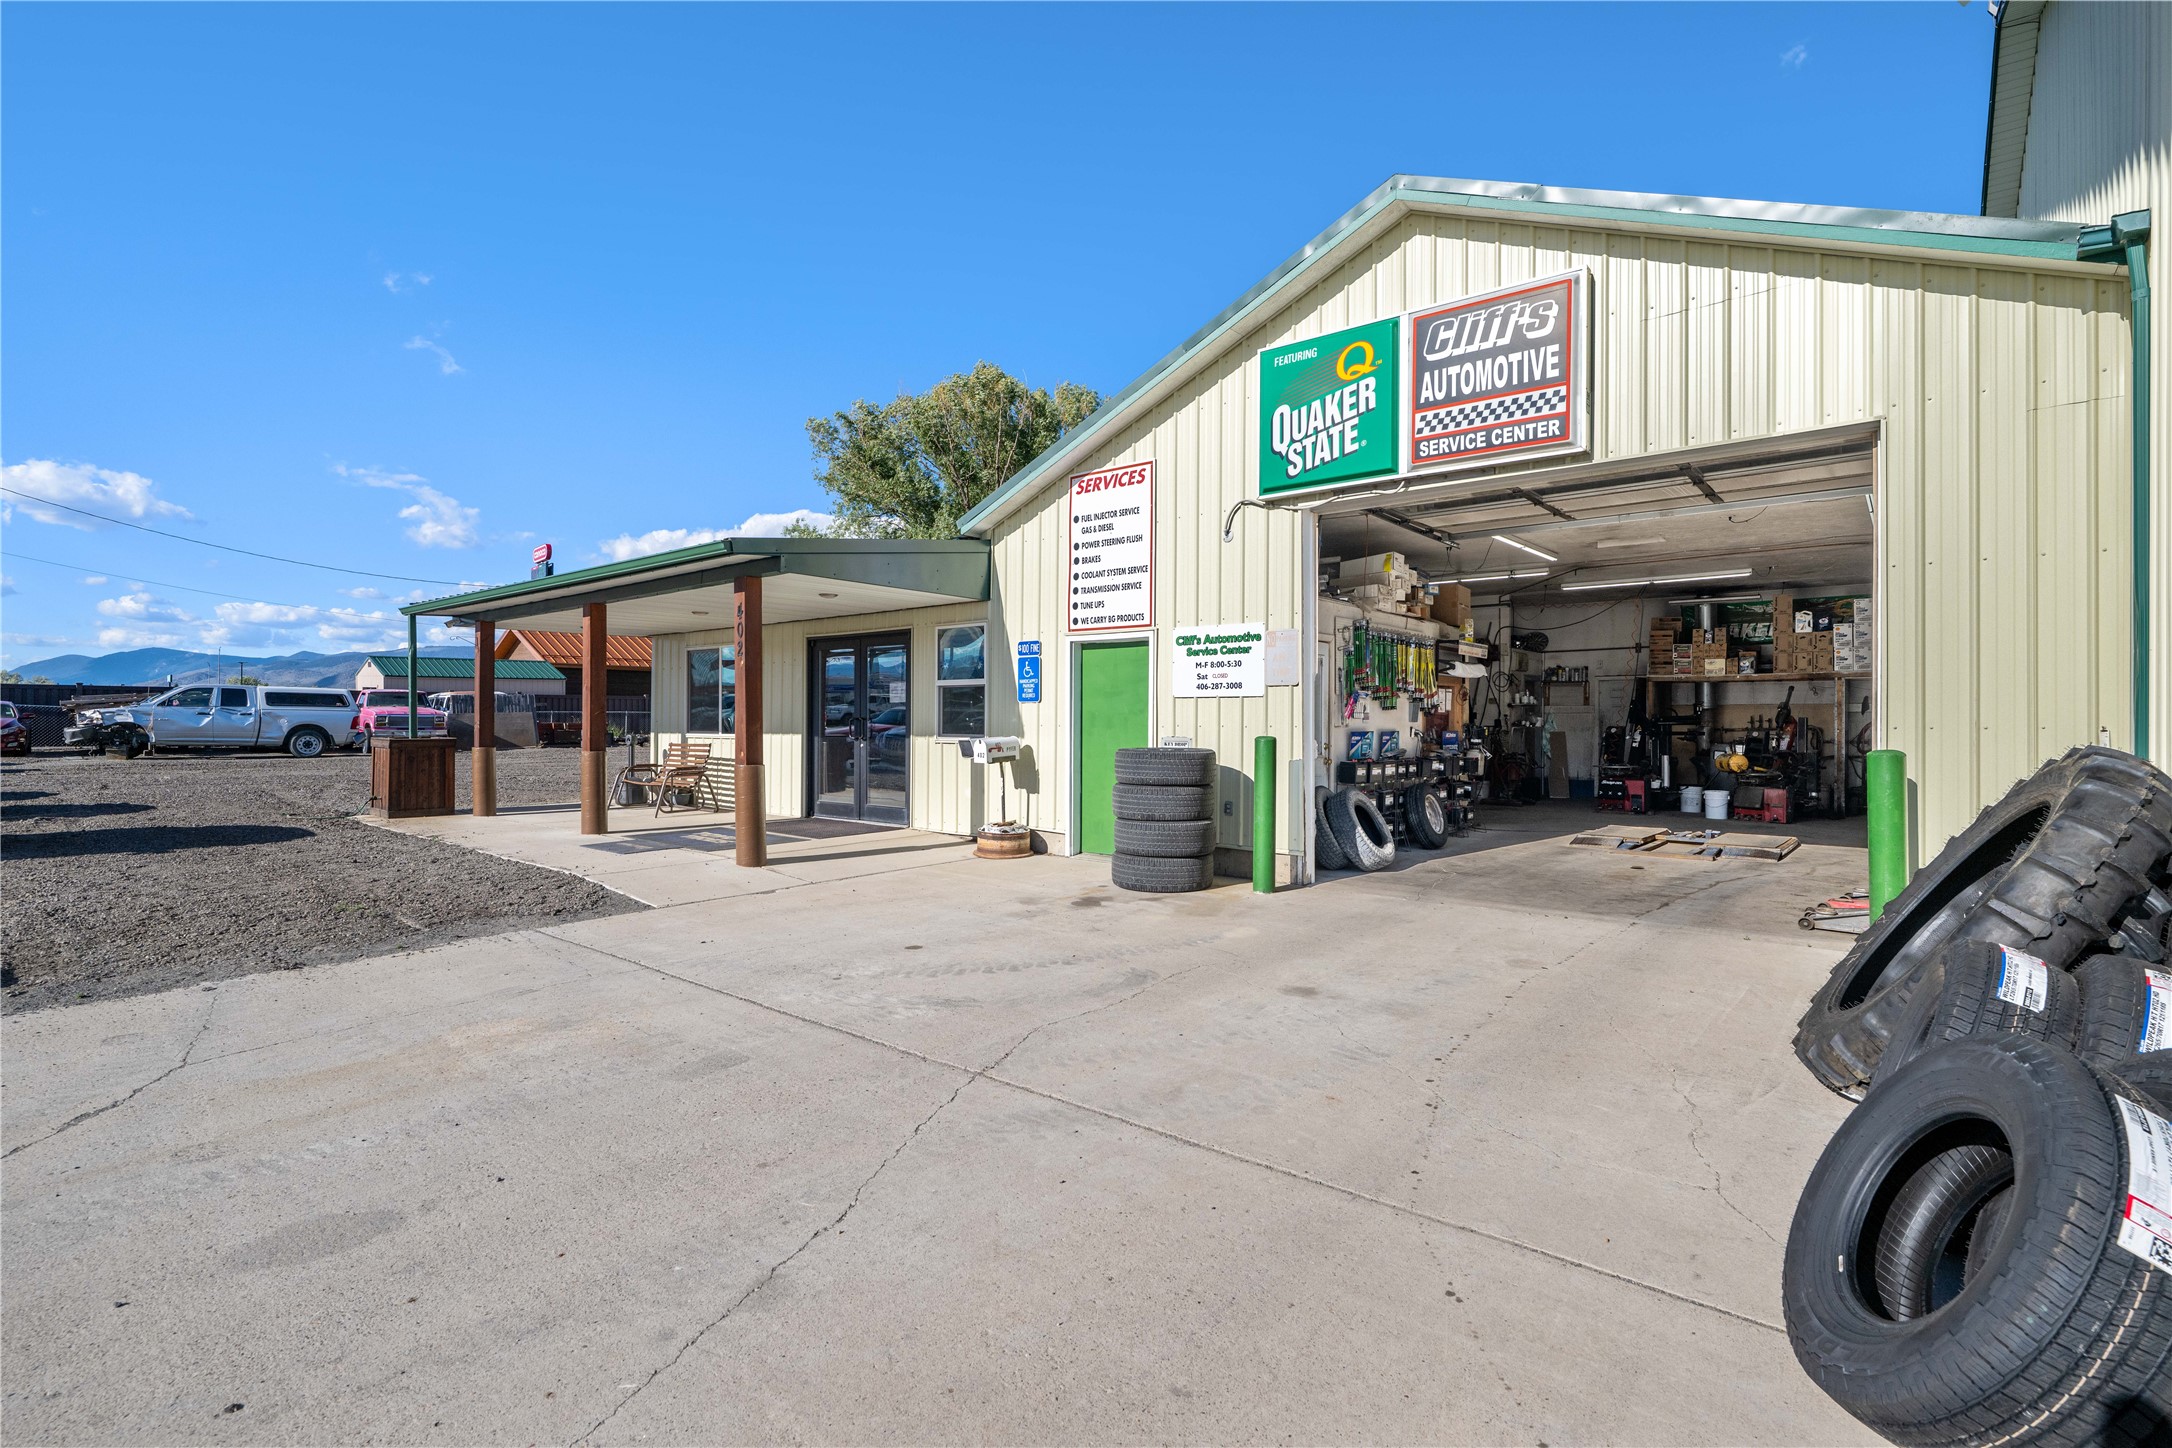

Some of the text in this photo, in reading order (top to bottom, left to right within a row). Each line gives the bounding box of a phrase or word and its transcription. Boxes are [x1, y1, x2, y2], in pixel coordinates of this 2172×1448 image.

[1423, 299, 1559, 361] Cliff's
[1274, 347, 1318, 368] FEATURING
[1420, 343, 1560, 403] AUTOMOTIVE
[1271, 376, 1377, 457] QUAKER
[1419, 419, 1561, 457] SERVICE CENTER
[1287, 420, 1360, 478] STATE
[1075, 467, 1147, 495] SERVICES
[1081, 506, 1140, 523] FUEL INJECTOR SERVICE
[1081, 523, 1114, 535] GAS & DIESEL
[1081, 534, 1143, 550] POWER STEERING FLUSH
[1081, 555, 1102, 565] BRAKES
[1081, 564, 1149, 580] COOLANT SYSTEM SERVICE
[1080, 581, 1142, 595] TRANSMISSION SERVICE
[1080, 600, 1105, 610] TUNE UPS
[1080, 613, 1145, 625] WE CARRY BG PRODUCTS
[1175, 634, 1202, 646] Cliff's
[1202, 631, 1262, 645] Automotive
[1186, 645, 1252, 657] Service Center
[1195, 660, 1242, 669] M-F 8:00-5:30
[2002, 975, 2012, 999] WILDPEAK
